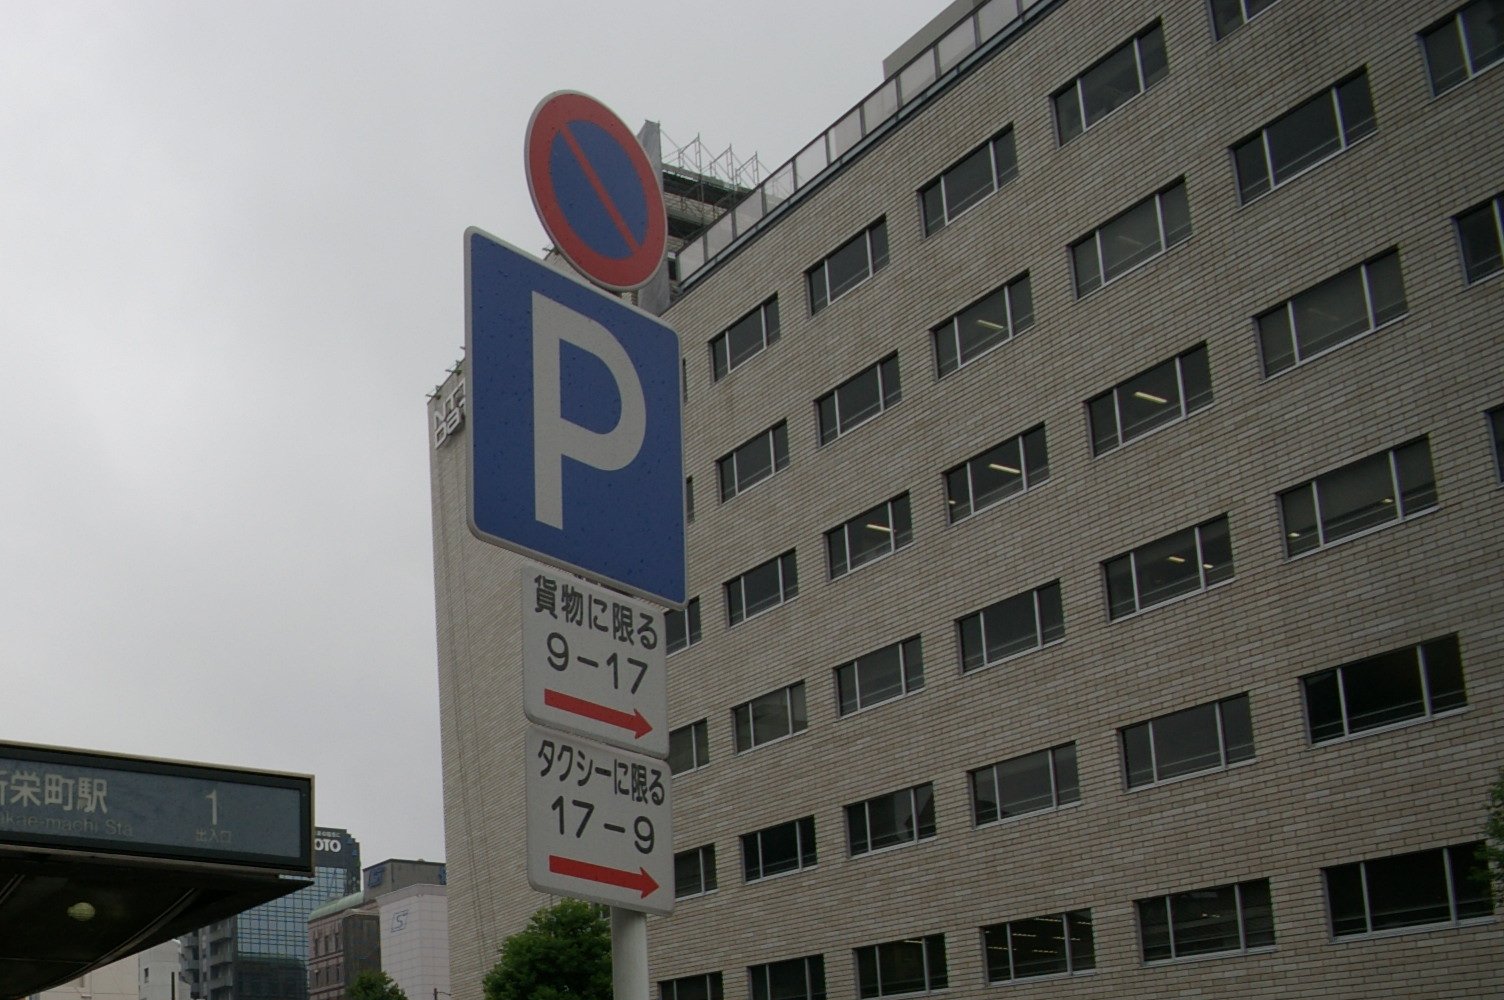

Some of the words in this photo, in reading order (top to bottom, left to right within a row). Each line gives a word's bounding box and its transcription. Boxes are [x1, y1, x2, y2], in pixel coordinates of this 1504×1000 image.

[530, 290, 648, 531] P
[534, 574, 658, 650] 貨物に限る
[538, 740, 665, 806] タクシーに限る
[195, 827, 233, 844] 出入口
[205, 788, 218, 826] 1
